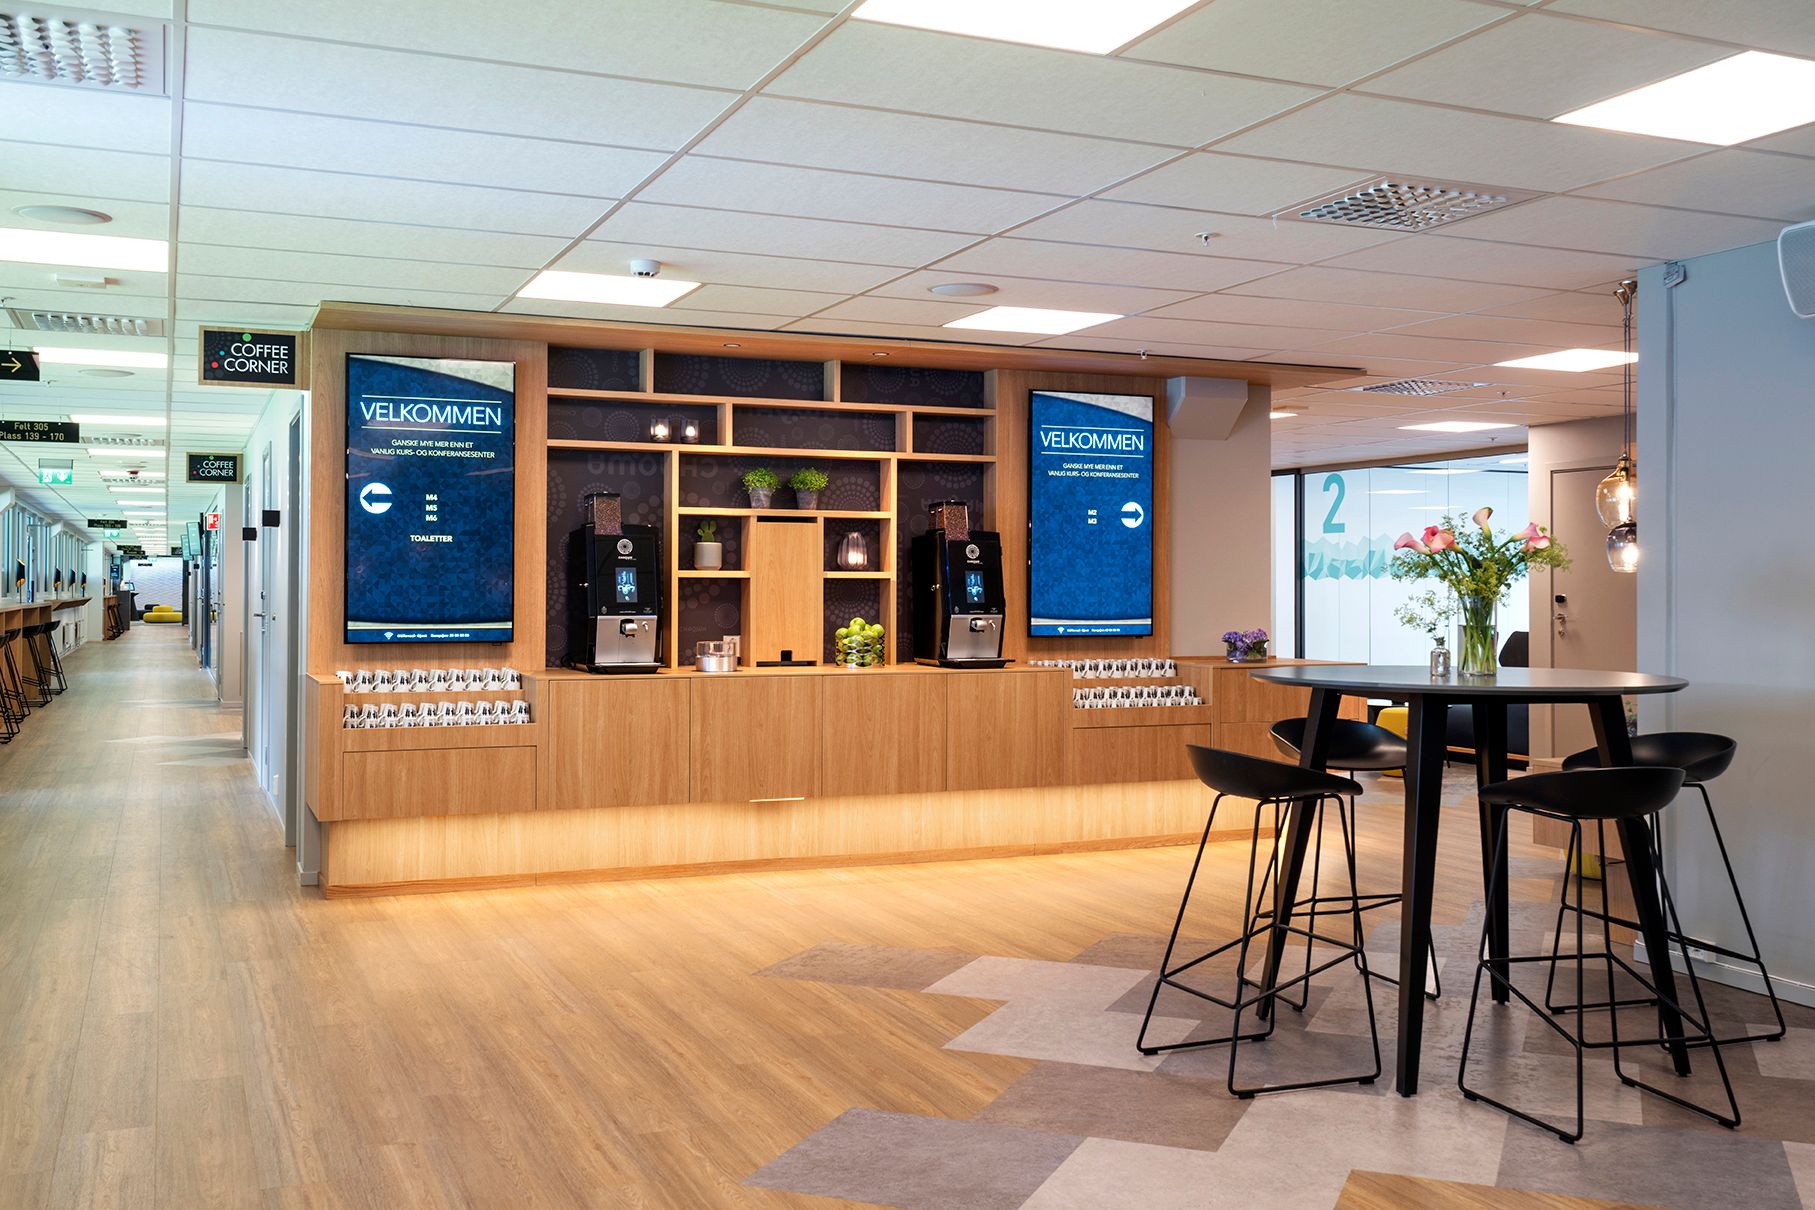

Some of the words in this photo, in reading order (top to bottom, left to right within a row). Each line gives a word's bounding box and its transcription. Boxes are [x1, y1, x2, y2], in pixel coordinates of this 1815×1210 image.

[231, 343, 288, 359] COFFEE
[224, 358, 288, 374] CORNER
[360, 402, 502, 425] VELKOMMEN
[14, 422, 30, 430] Felt
[34, 423, 48, 431] 305
[26, 432, 39, 440] 139
[1040, 431, 1144, 450] VELKOMMEN
[392, 439, 418, 447] GANSKE
[435, 440, 449, 448] MER
[371, 448, 395, 456] VANLIG
[428, 450, 495, 458] KONFERANSESENTER
[203, 461, 233, 469] COFFEE
[200, 468, 233, 476] CORNER
[1323, 473, 1346, 533] 2
[426, 504, 437, 512] M5
[410, 535, 452, 543] TOALETTER
